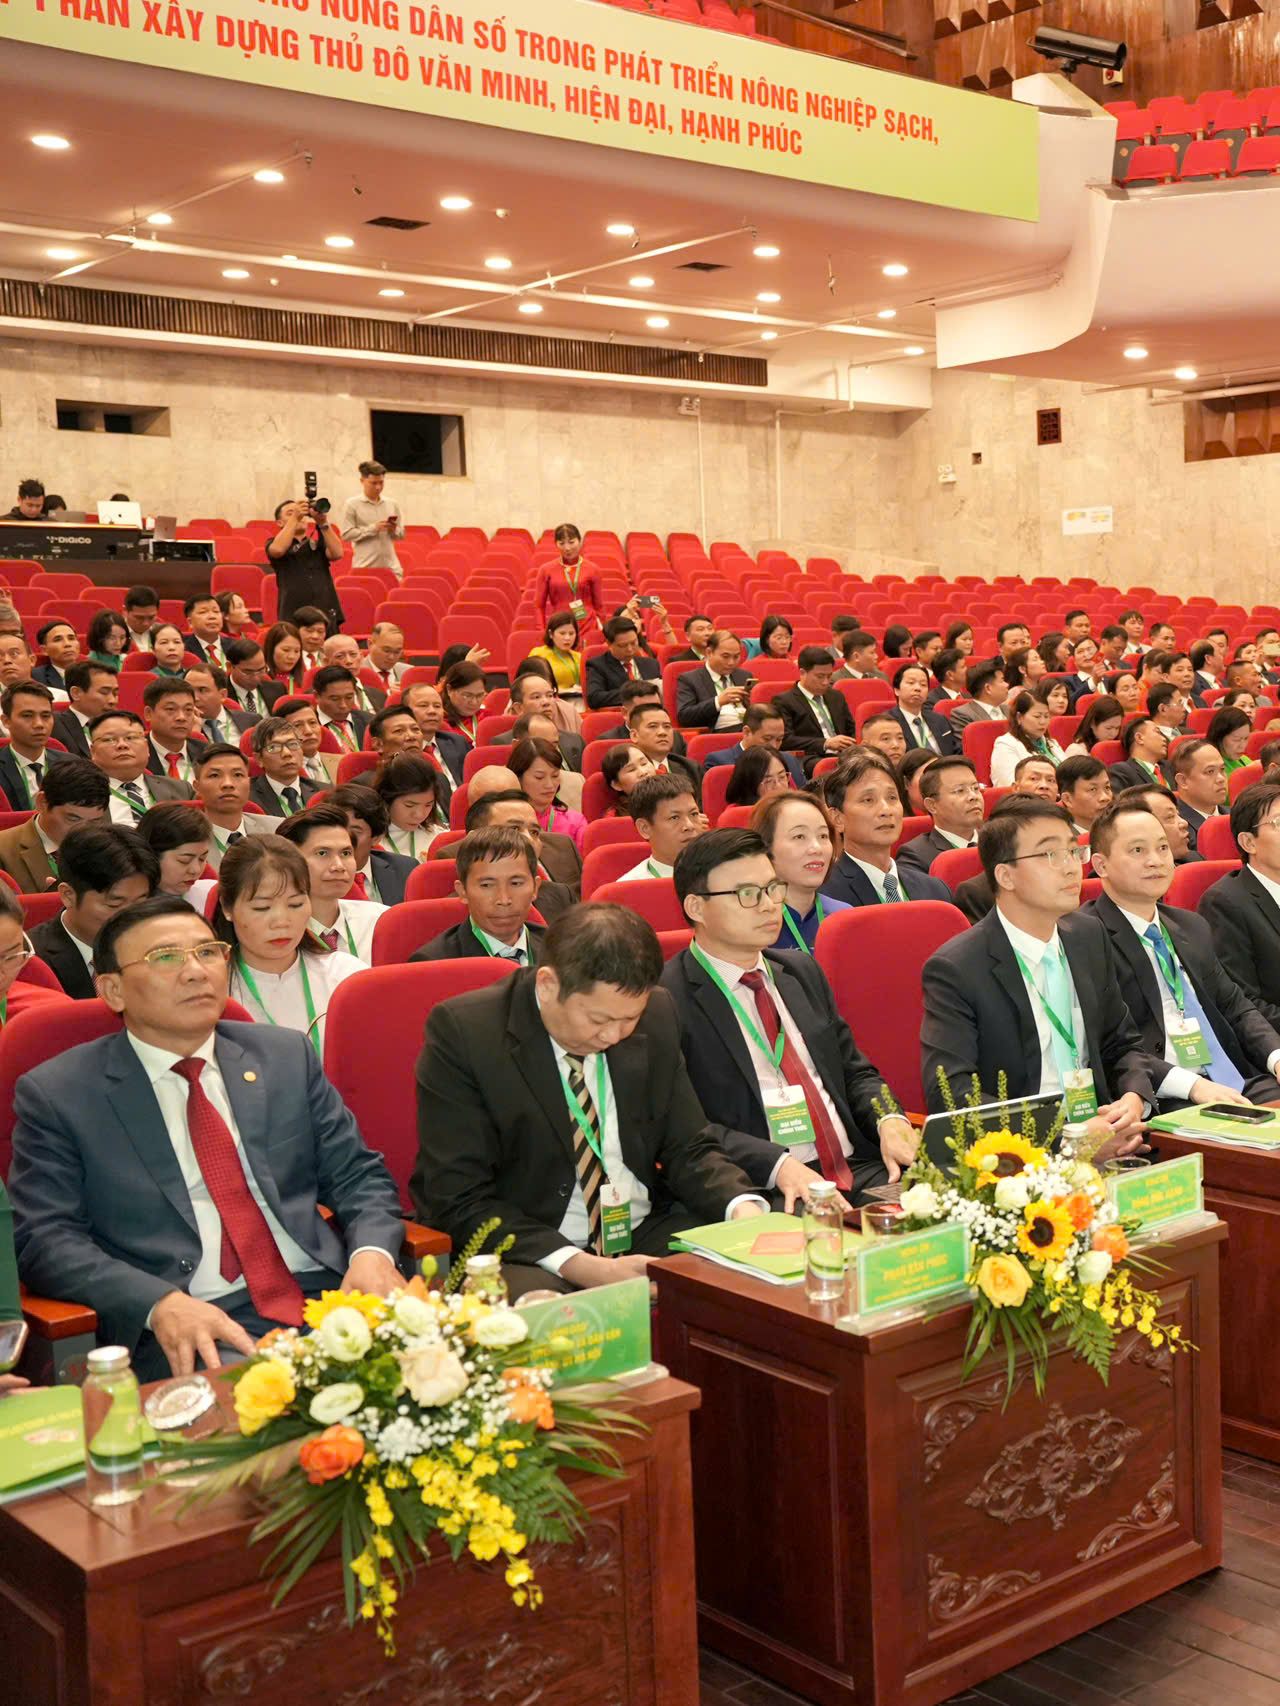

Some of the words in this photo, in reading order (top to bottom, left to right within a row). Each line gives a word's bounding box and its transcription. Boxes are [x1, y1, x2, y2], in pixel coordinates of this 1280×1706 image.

[142, 0, 204, 42] XÂY
[216, 15, 299, 60] DỰNG
[309, 32, 364, 72] THỦ
[373, 46, 409, 81] ĐÔ
[418, 53, 472, 93] VĂN
[481, 68, 556, 112] MINH,
[564, 85, 620, 124] HIỆN
[628, 97, 673, 135] ĐẠI,
[681, 108, 740, 144] HẠNH
[748, 122, 802, 155] PHÚC
[408, 5, 463, 45] DÂN
[473, 16, 507, 53] SỐ
[515, 29, 596, 72] TRONG
[604, 48, 662, 85] PHÁT
[670, 61, 733, 100] TRIỂN
[741, 76, 798, 114] NÔNG
[806, 91, 877, 132] NGHIỆP
[884, 108, 938, 145] SẠCH,
